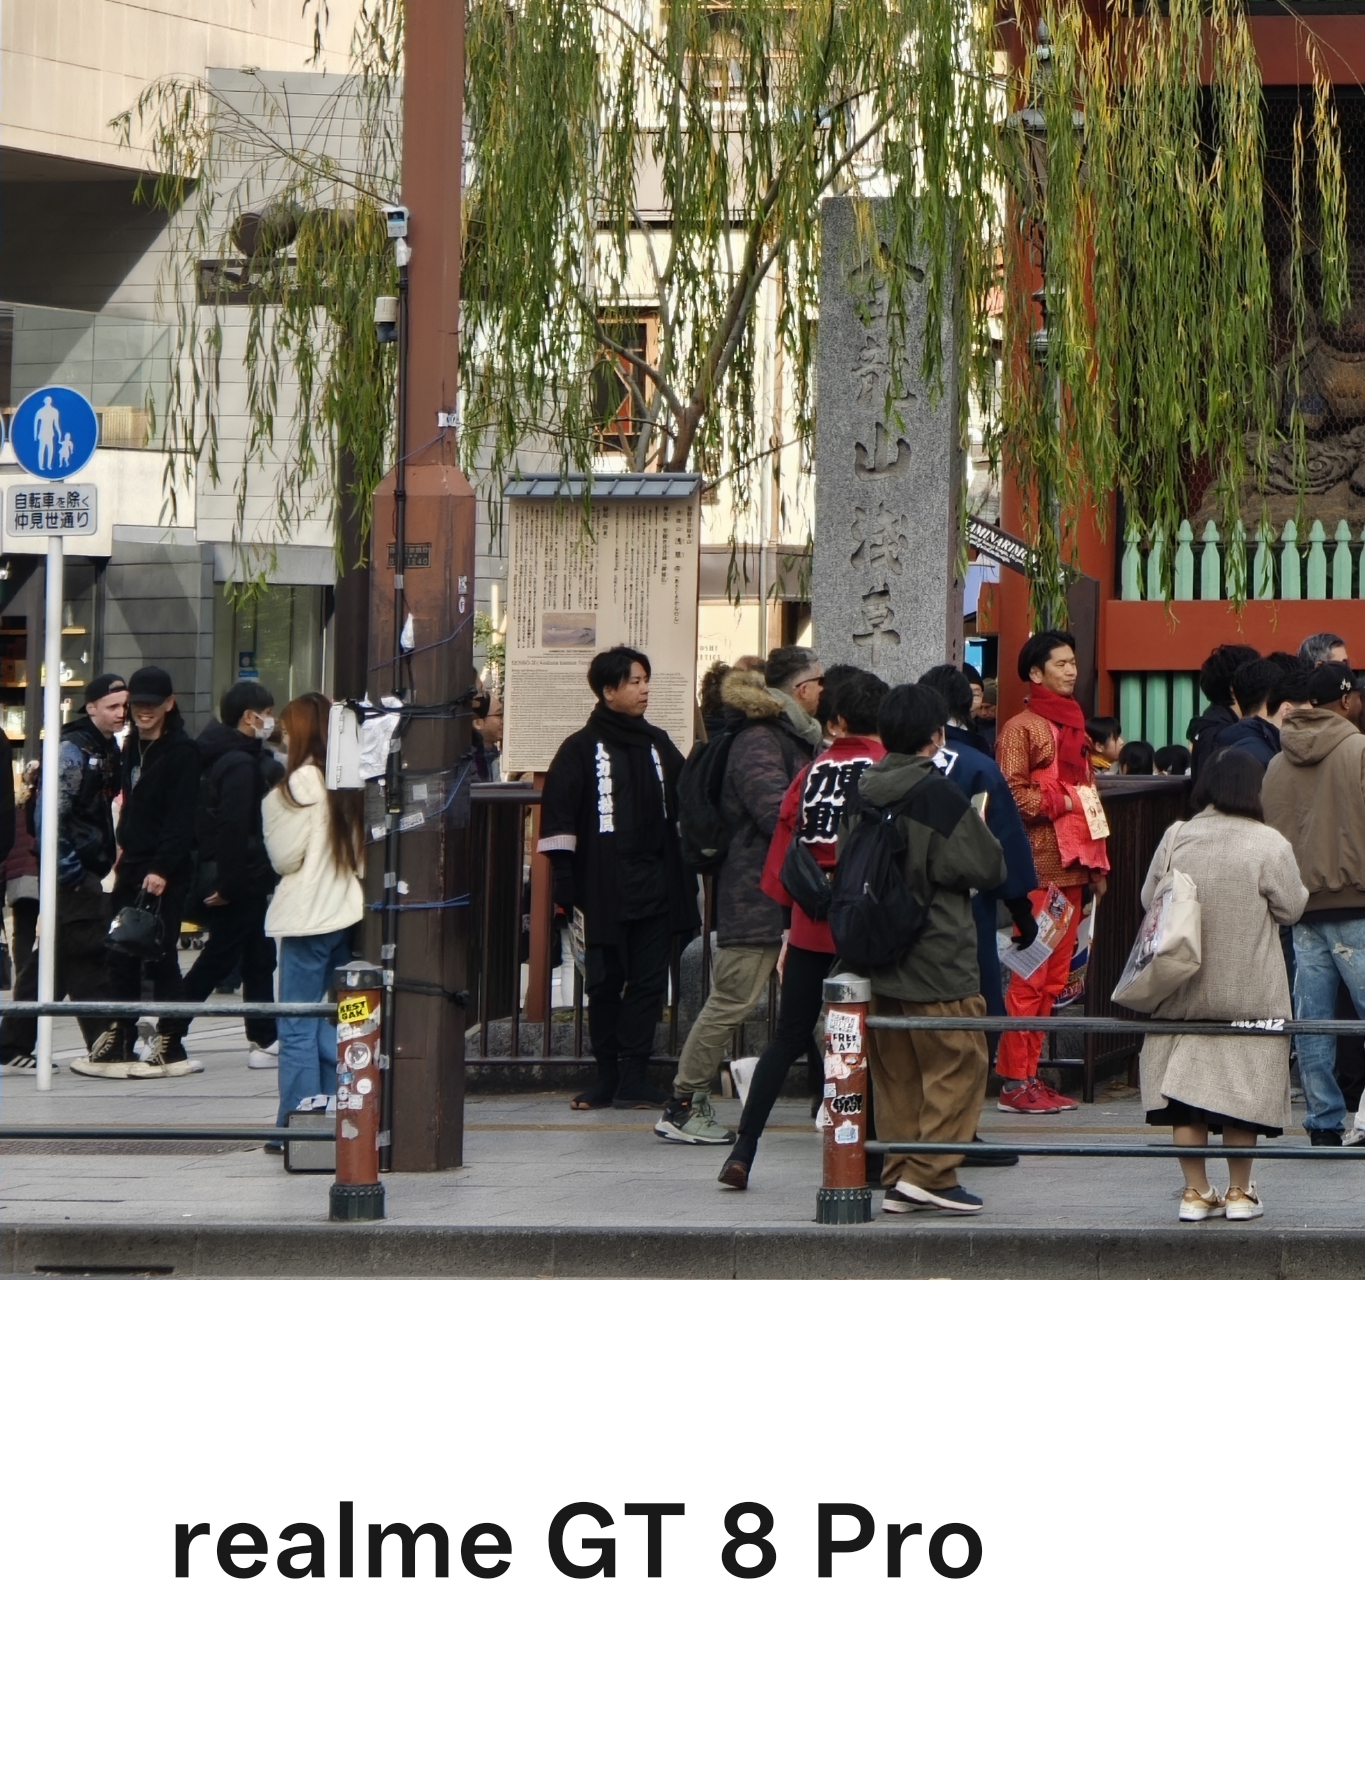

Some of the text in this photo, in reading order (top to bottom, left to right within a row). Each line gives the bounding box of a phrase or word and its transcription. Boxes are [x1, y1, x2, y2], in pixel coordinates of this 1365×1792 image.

[14, 490, 90, 510] 自転車を除く
[14, 511, 90, 530] 仲見世通り
